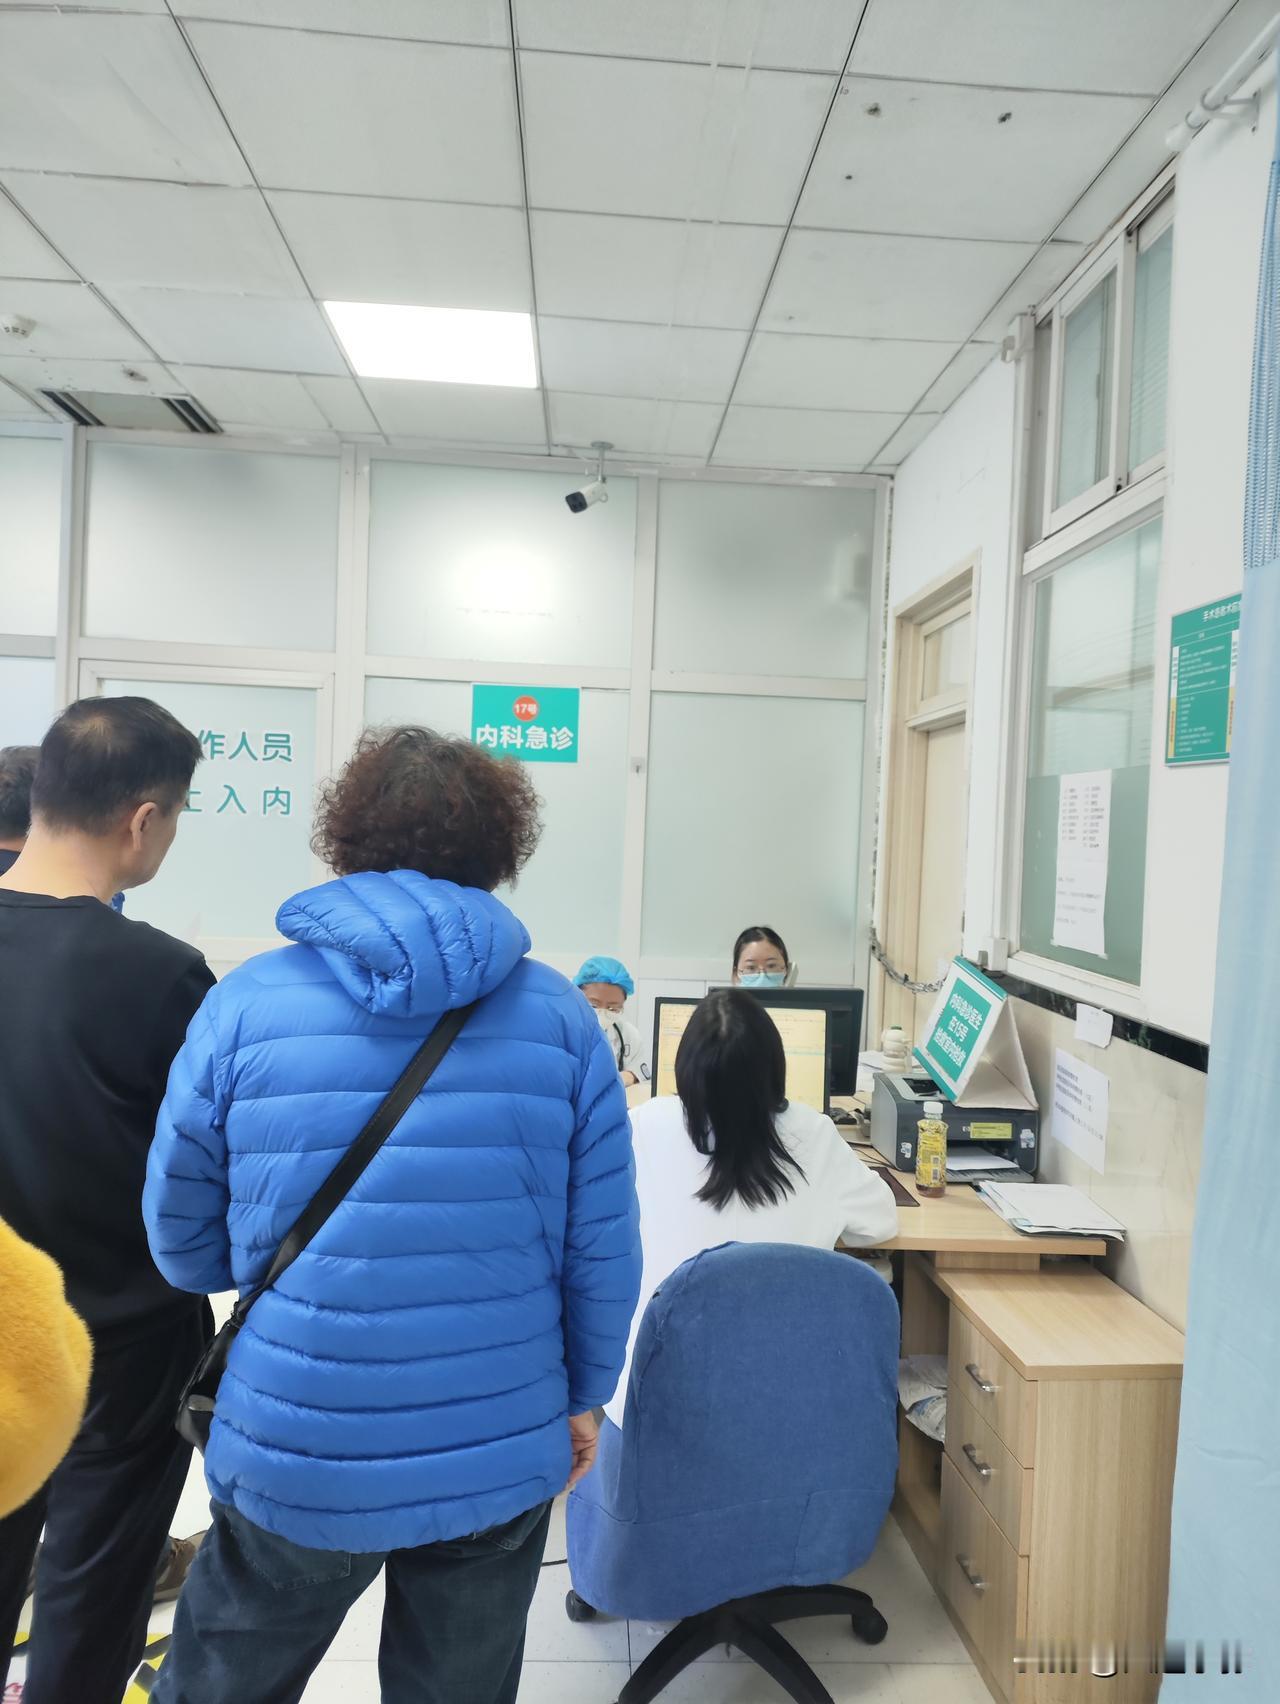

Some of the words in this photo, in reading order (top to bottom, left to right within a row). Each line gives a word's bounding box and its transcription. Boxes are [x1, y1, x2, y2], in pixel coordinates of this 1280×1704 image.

[514, 703, 537, 715] 17号
[199, 729, 292, 762] 作人员
[475, 723, 574, 751] 内科急诊
[948, 1015, 969, 1042] 在15号
